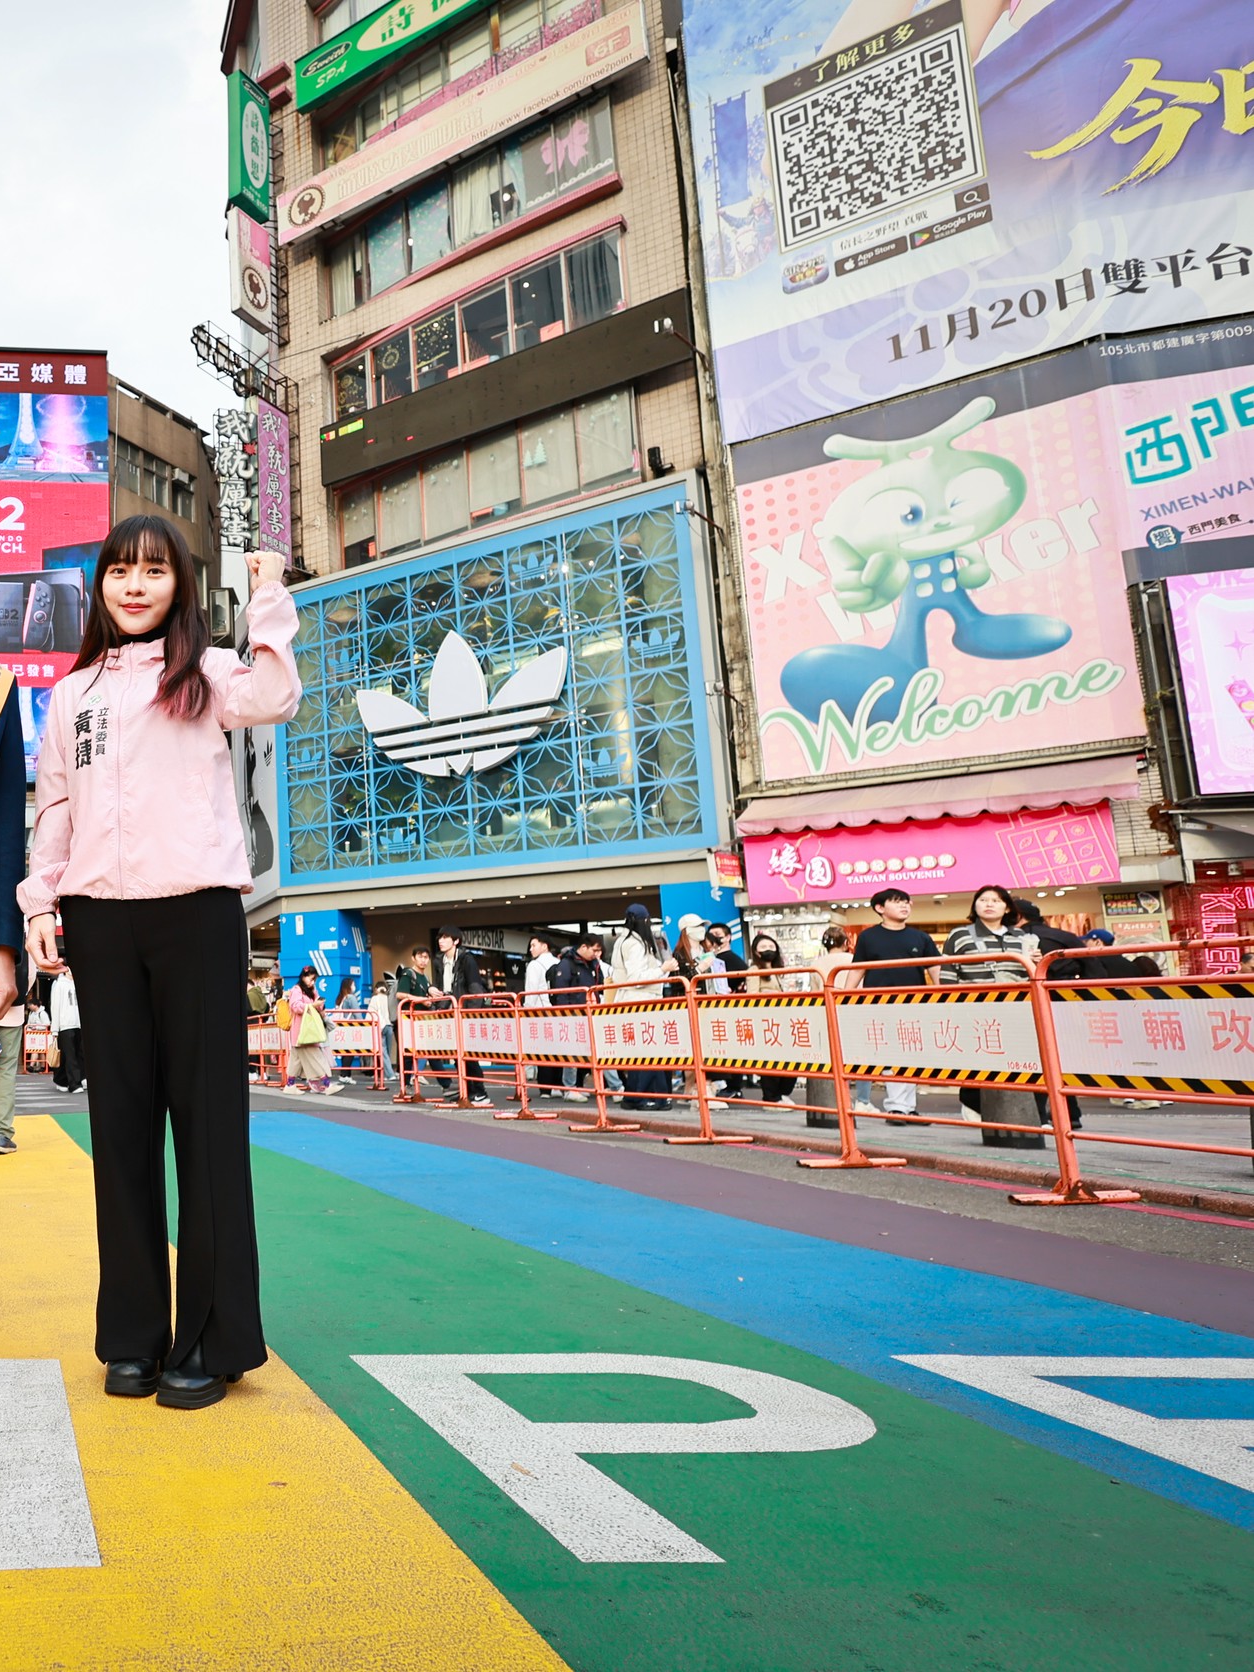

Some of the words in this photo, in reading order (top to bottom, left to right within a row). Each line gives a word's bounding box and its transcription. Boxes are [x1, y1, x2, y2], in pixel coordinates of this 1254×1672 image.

[593, 33, 623, 58] 6F
[808, 23, 916, 84] 了解更多
[316, 61, 348, 89] SPA
[933, 217, 966, 235] Google
[967, 209, 987, 224] Play
[857, 250, 874, 262] App
[874, 242, 896, 256] Store
[888, 240, 1254, 364] 11月20日雙平台
[1186, 513, 1242, 536] 西門美食
[761, 659, 1126, 774] Welcome
[74, 709, 93, 770] 黃捷
[95, 707, 109, 755] 立法委員
[846, 874, 886, 885] TAIWAN
[889, 869, 945, 882] SOUVENIR
[462, 928, 505, 950] SUPERSTAR
[334, 1029, 363, 1042] 改道
[419, 1024, 452, 1040] 車輛改道
[468, 1023, 513, 1042] 車輛改道
[529, 1021, 587, 1043] 車輛改道
[603, 1020, 680, 1047] 車輛改道
[710, 1018, 812, 1048] 車輛改道
[863, 1018, 1007, 1056] 車輛改道
[1007, 1061, 1039, 1072] 108-460
